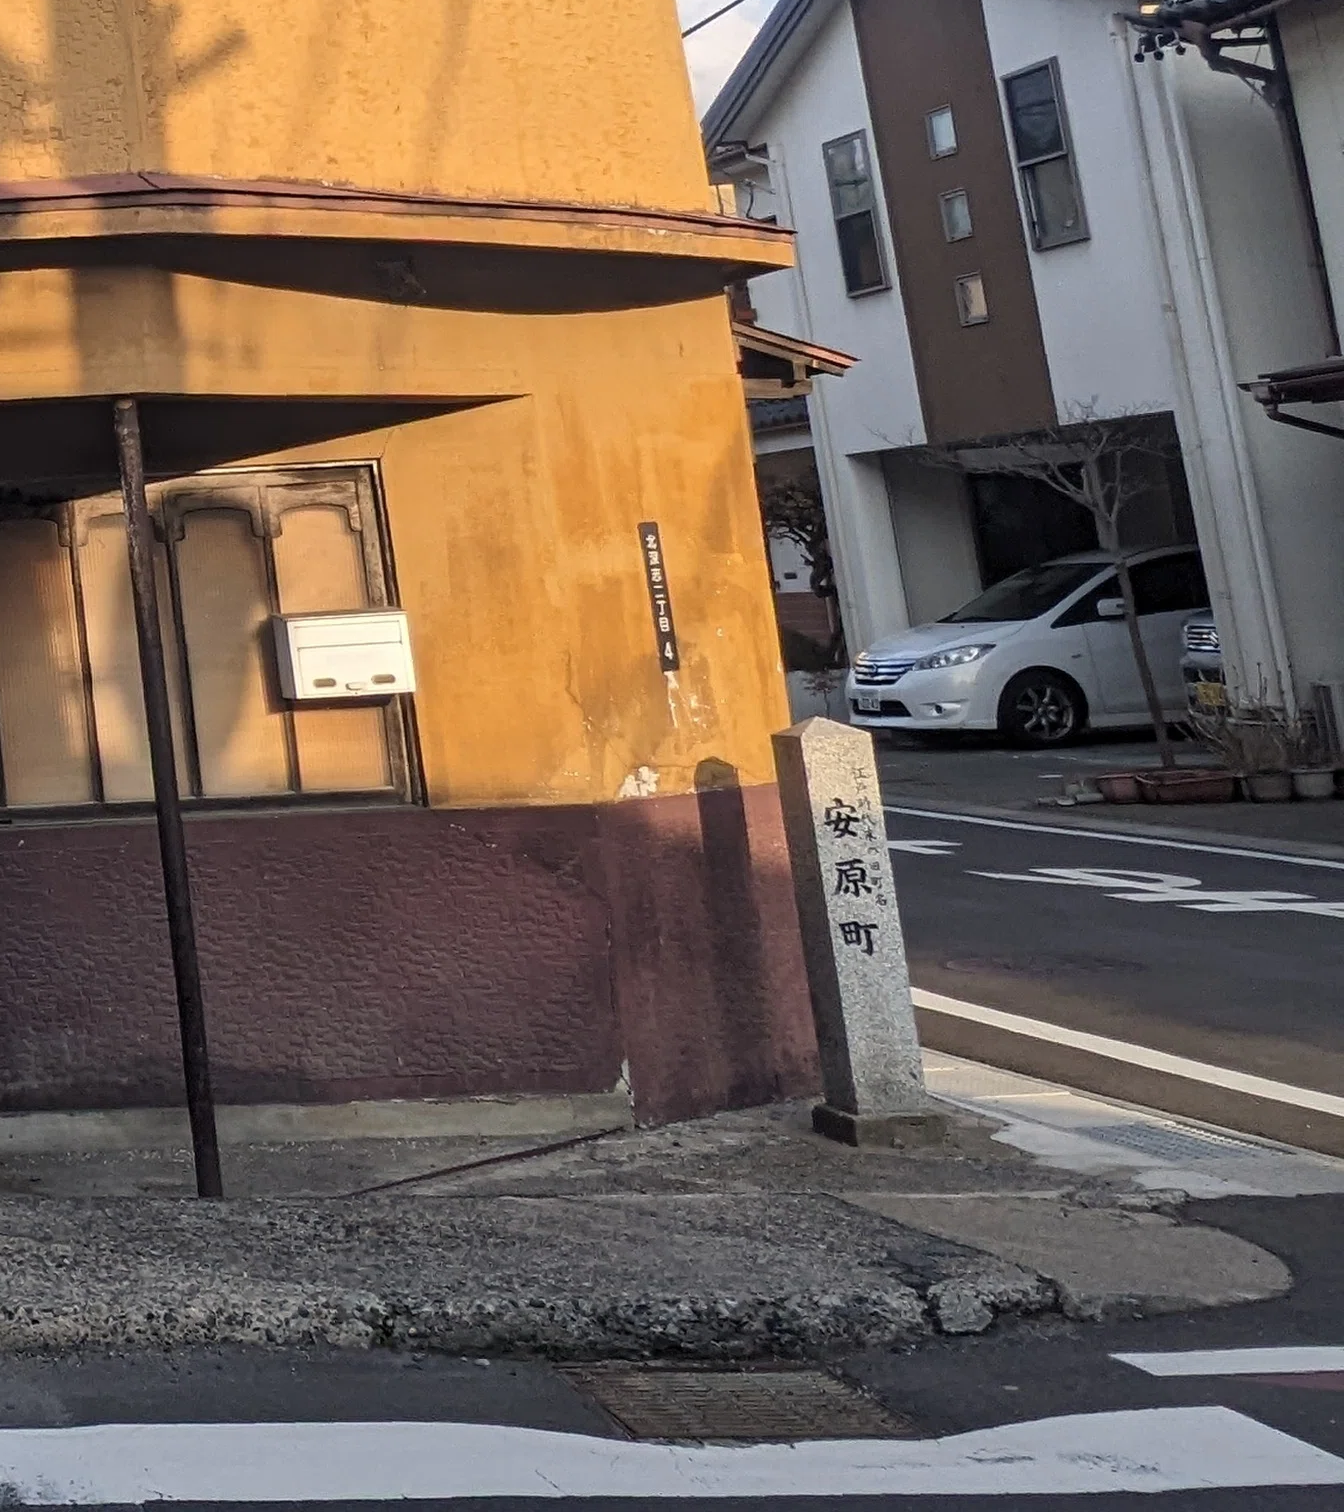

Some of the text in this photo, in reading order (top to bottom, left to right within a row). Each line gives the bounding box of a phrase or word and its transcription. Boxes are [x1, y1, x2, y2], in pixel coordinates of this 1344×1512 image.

[664, 641, 674, 660] 4
[824, 797, 878, 956] 安原町
